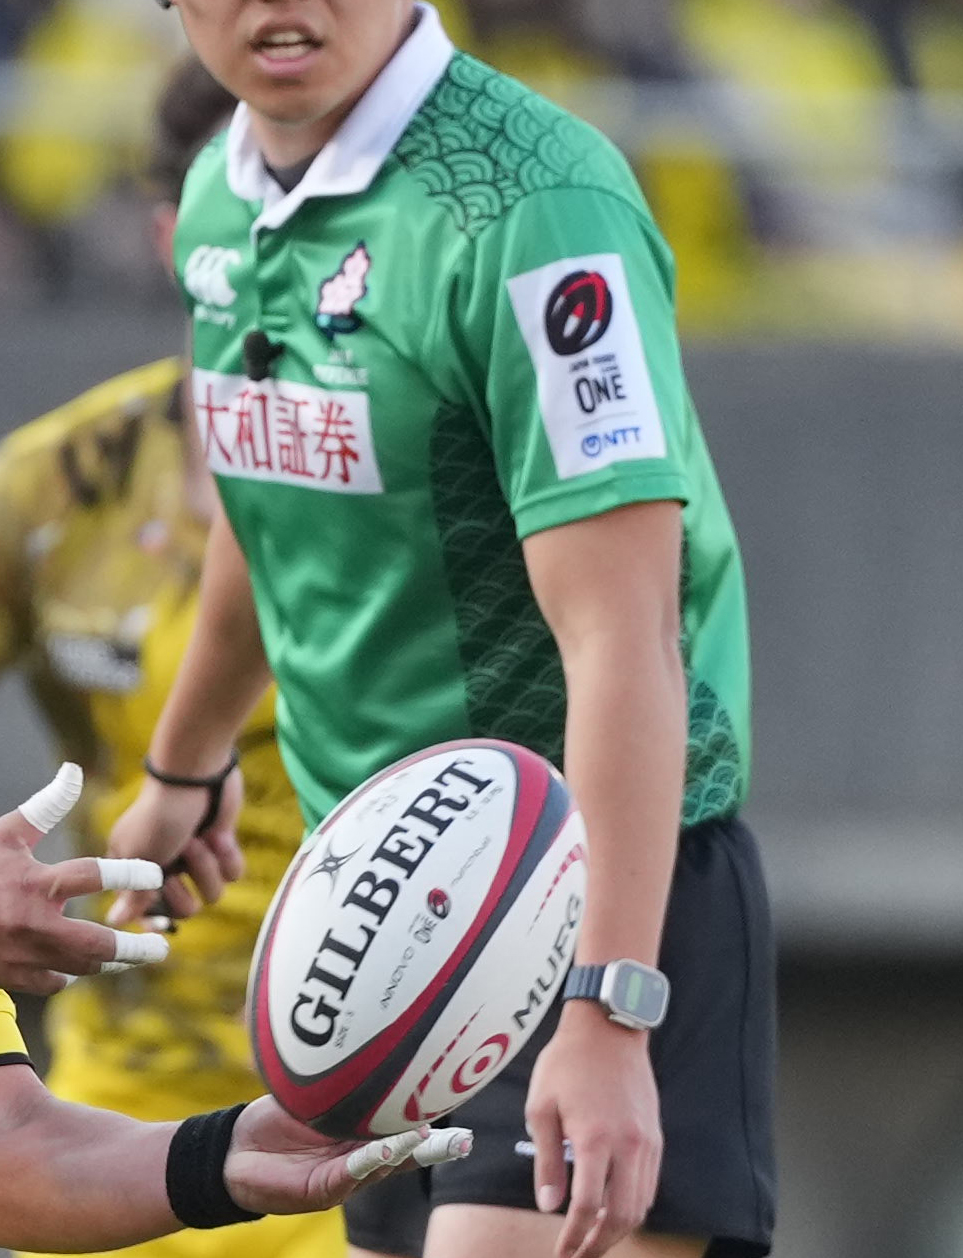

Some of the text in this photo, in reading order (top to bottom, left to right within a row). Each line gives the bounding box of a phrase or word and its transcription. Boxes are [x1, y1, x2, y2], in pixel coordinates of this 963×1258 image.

[197, 383, 359, 485] 大和証券
[574, 374, 627, 413] ONE
[604, 427, 640, 447] NTT
[291, 760, 493, 1047] GILBERT
[512, 892, 580, 1031] MUFG
